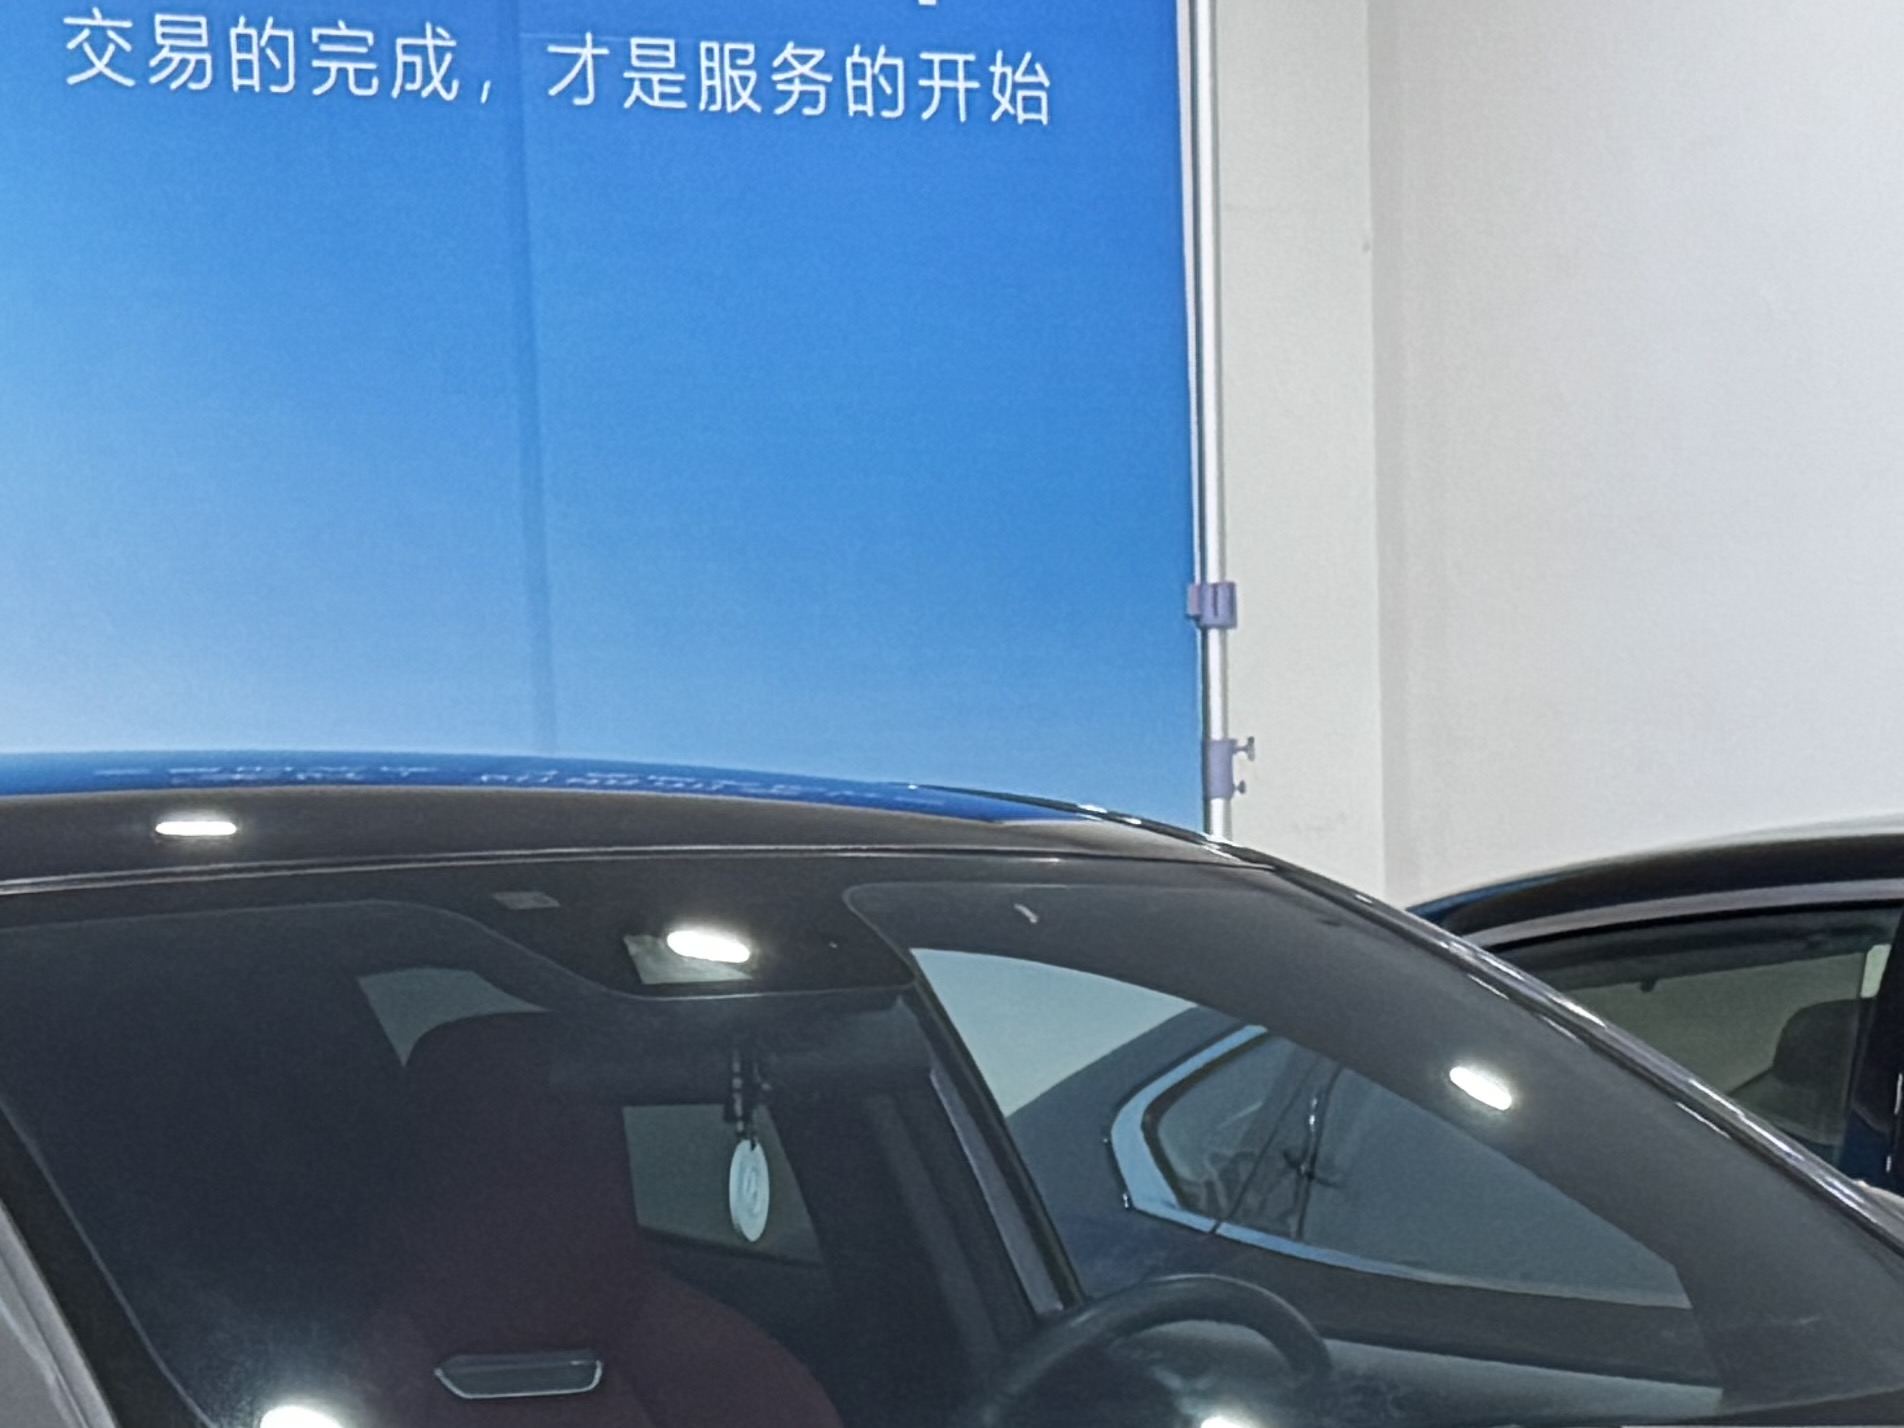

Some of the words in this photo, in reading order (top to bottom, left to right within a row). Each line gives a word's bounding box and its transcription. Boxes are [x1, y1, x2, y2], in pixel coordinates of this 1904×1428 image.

[63, 7, 1050, 125] 交易的完成，才是服务的开始
